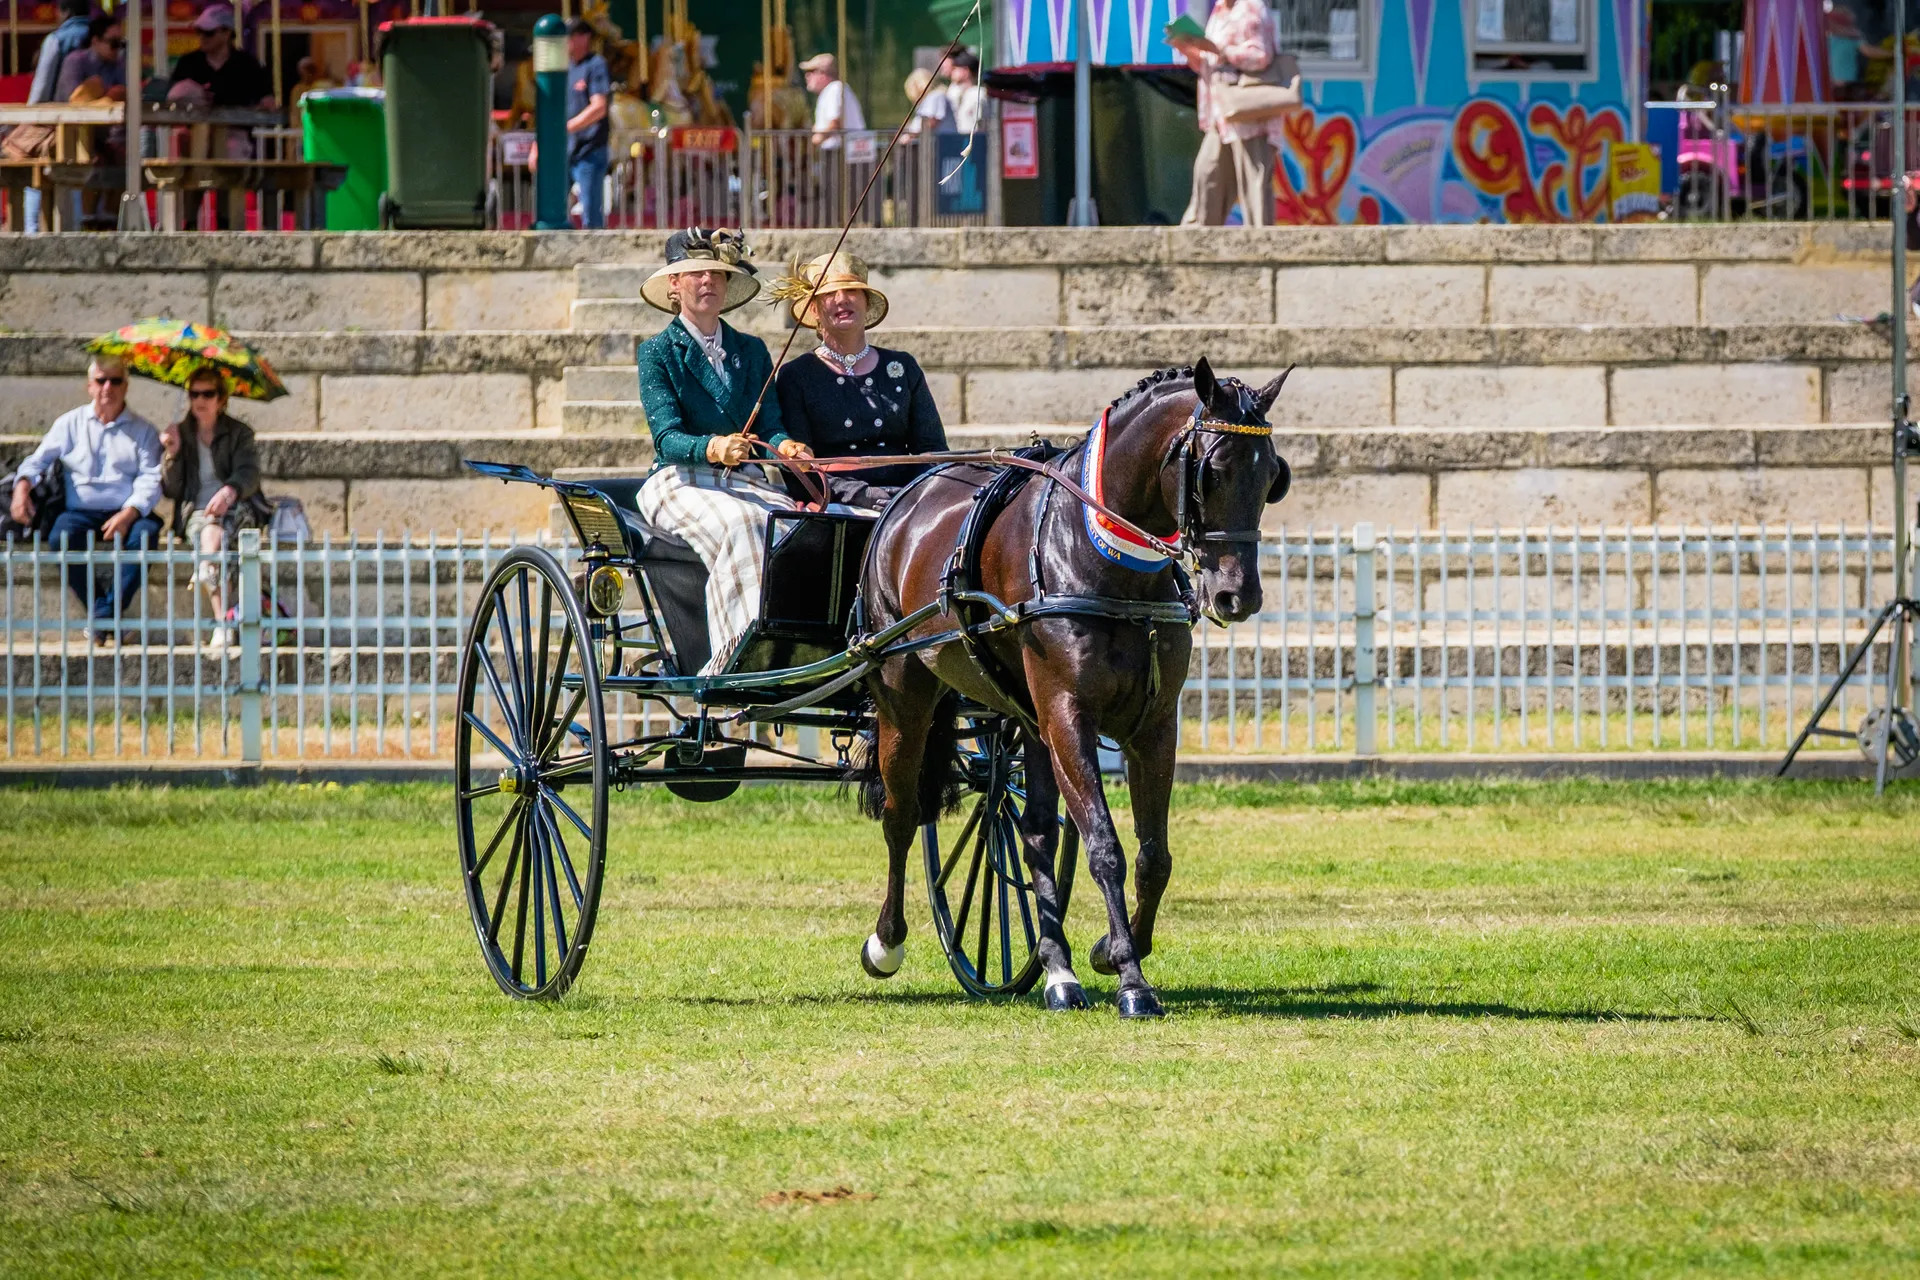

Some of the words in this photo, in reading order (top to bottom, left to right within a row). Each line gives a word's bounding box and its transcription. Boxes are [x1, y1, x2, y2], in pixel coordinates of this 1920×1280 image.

[683, 129, 721, 148] EXIT
[1097, 539, 1108, 550] OF
[1107, 547, 1121, 560] WA
